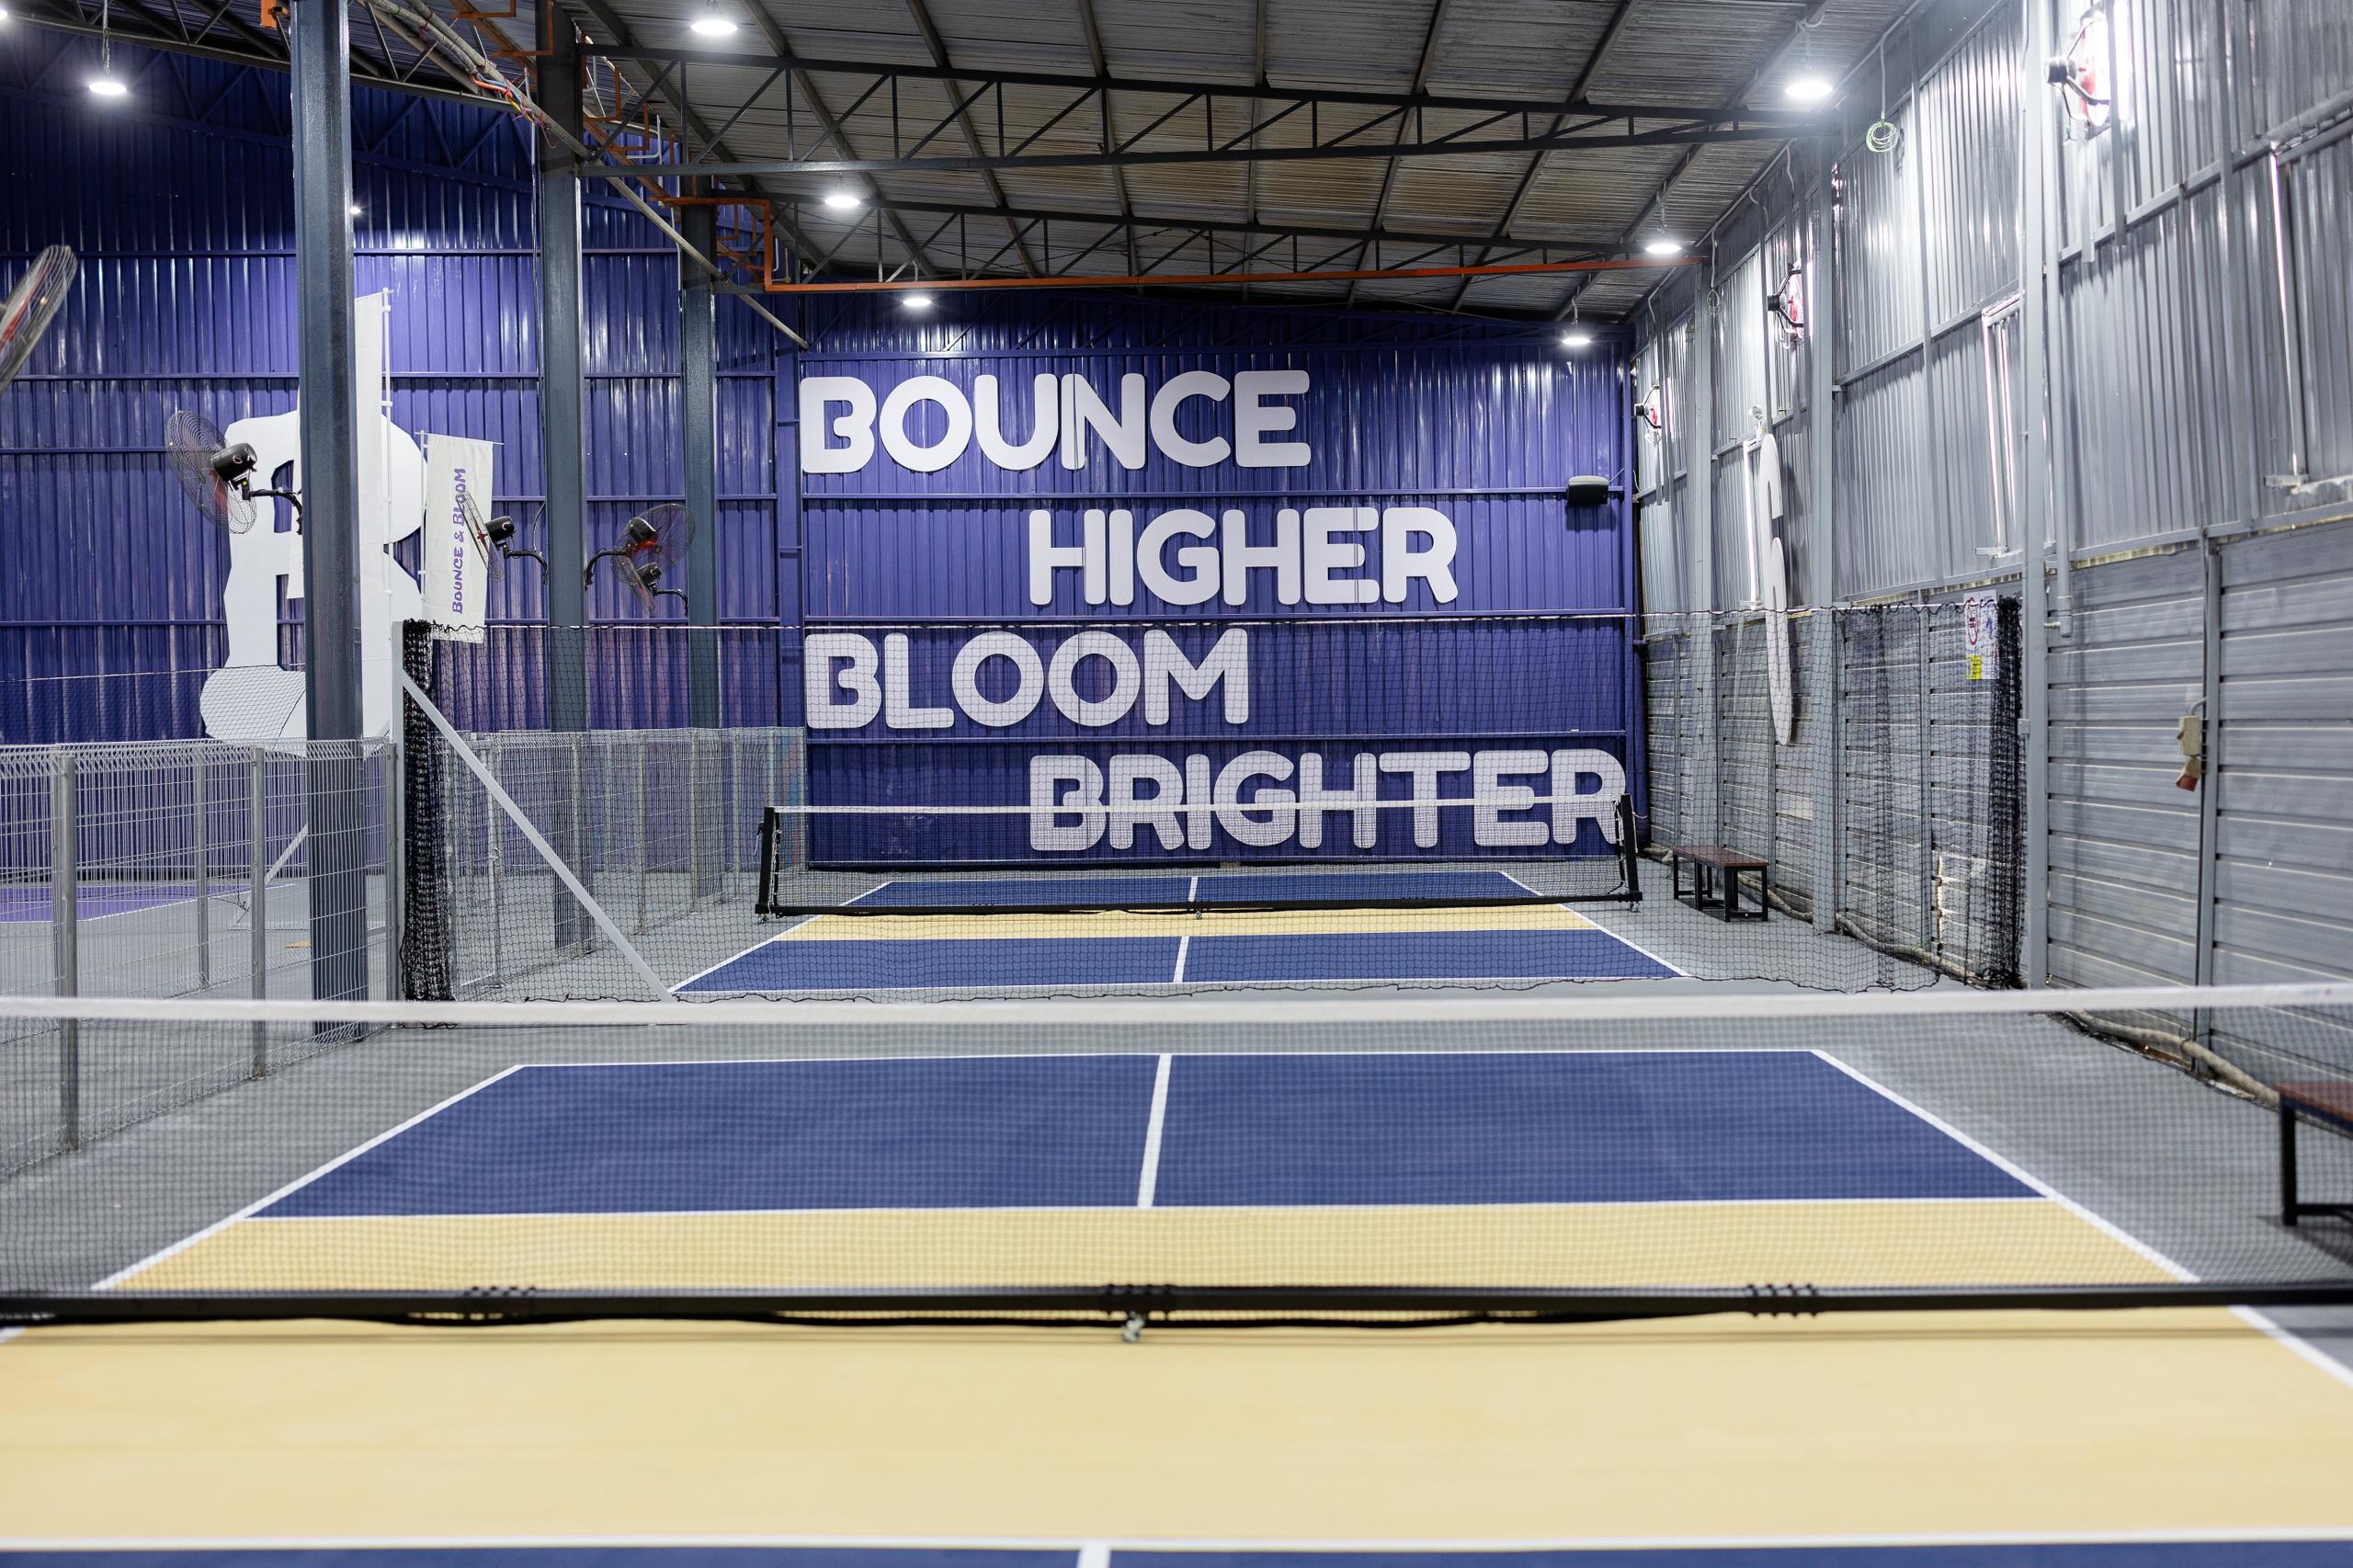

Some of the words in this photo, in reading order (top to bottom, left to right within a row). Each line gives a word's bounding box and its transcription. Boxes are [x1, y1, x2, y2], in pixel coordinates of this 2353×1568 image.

[800, 370, 1312, 473] BOUNCE
[453, 468, 466, 526] BLOOM
[454, 531, 463, 542] &
[452, 547, 464, 614] BOUNCE
[1029, 507, 1458, 605] HIGHER
[805, 628, 1249, 729] BLOOM
[1029, 749, 1625, 851] BRIGHTER
